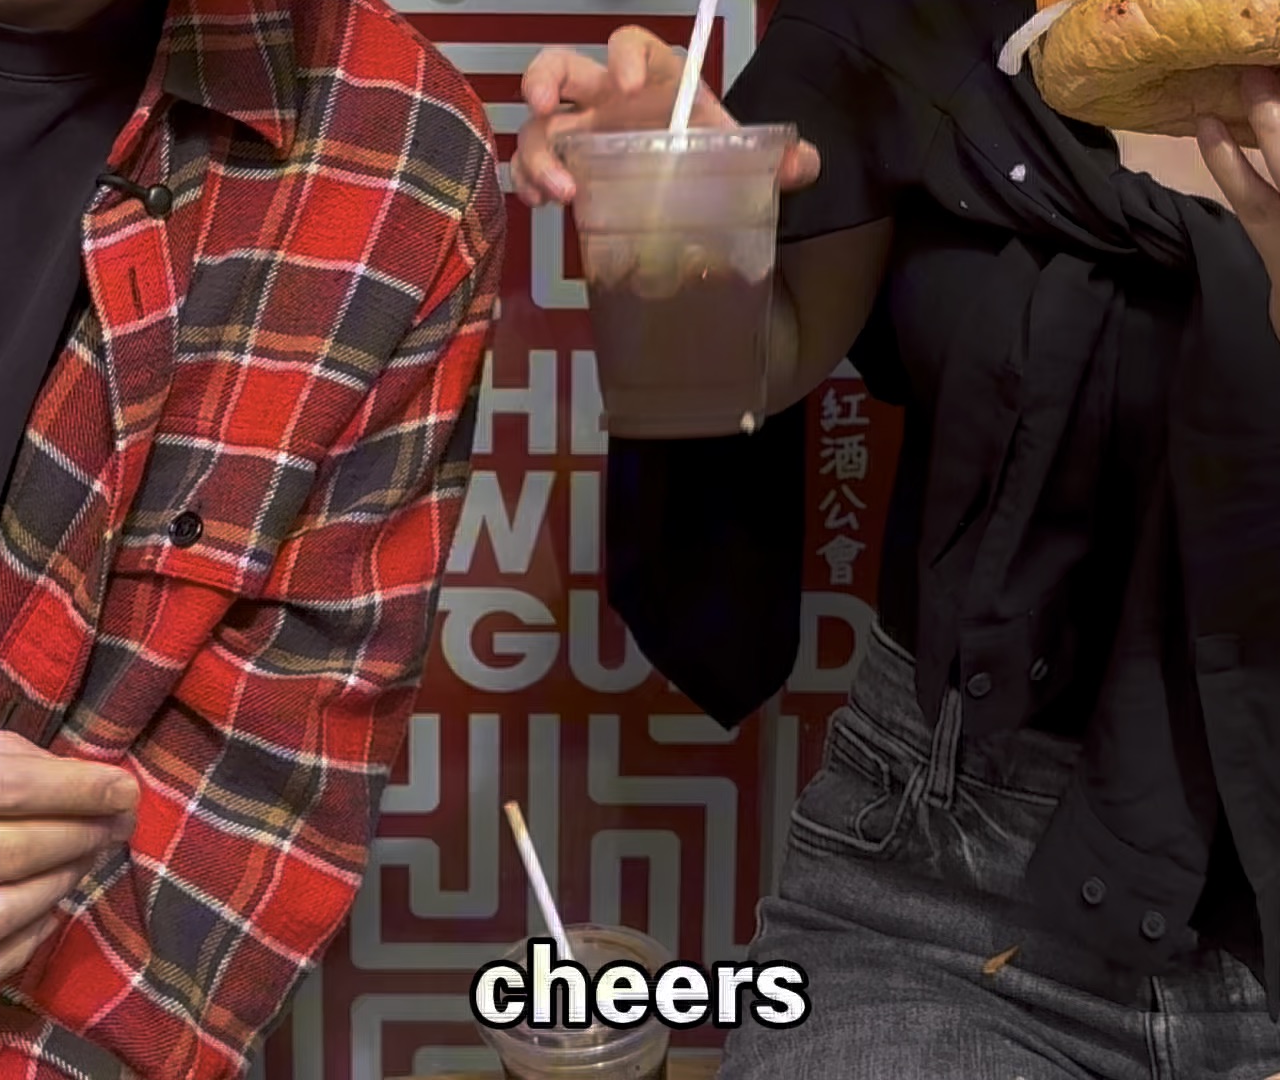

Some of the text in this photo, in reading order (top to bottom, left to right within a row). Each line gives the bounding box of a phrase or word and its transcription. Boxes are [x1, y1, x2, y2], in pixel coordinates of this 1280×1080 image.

[442, 471, 601, 575] WI
[816, 386, 870, 586] 紅酒公會
